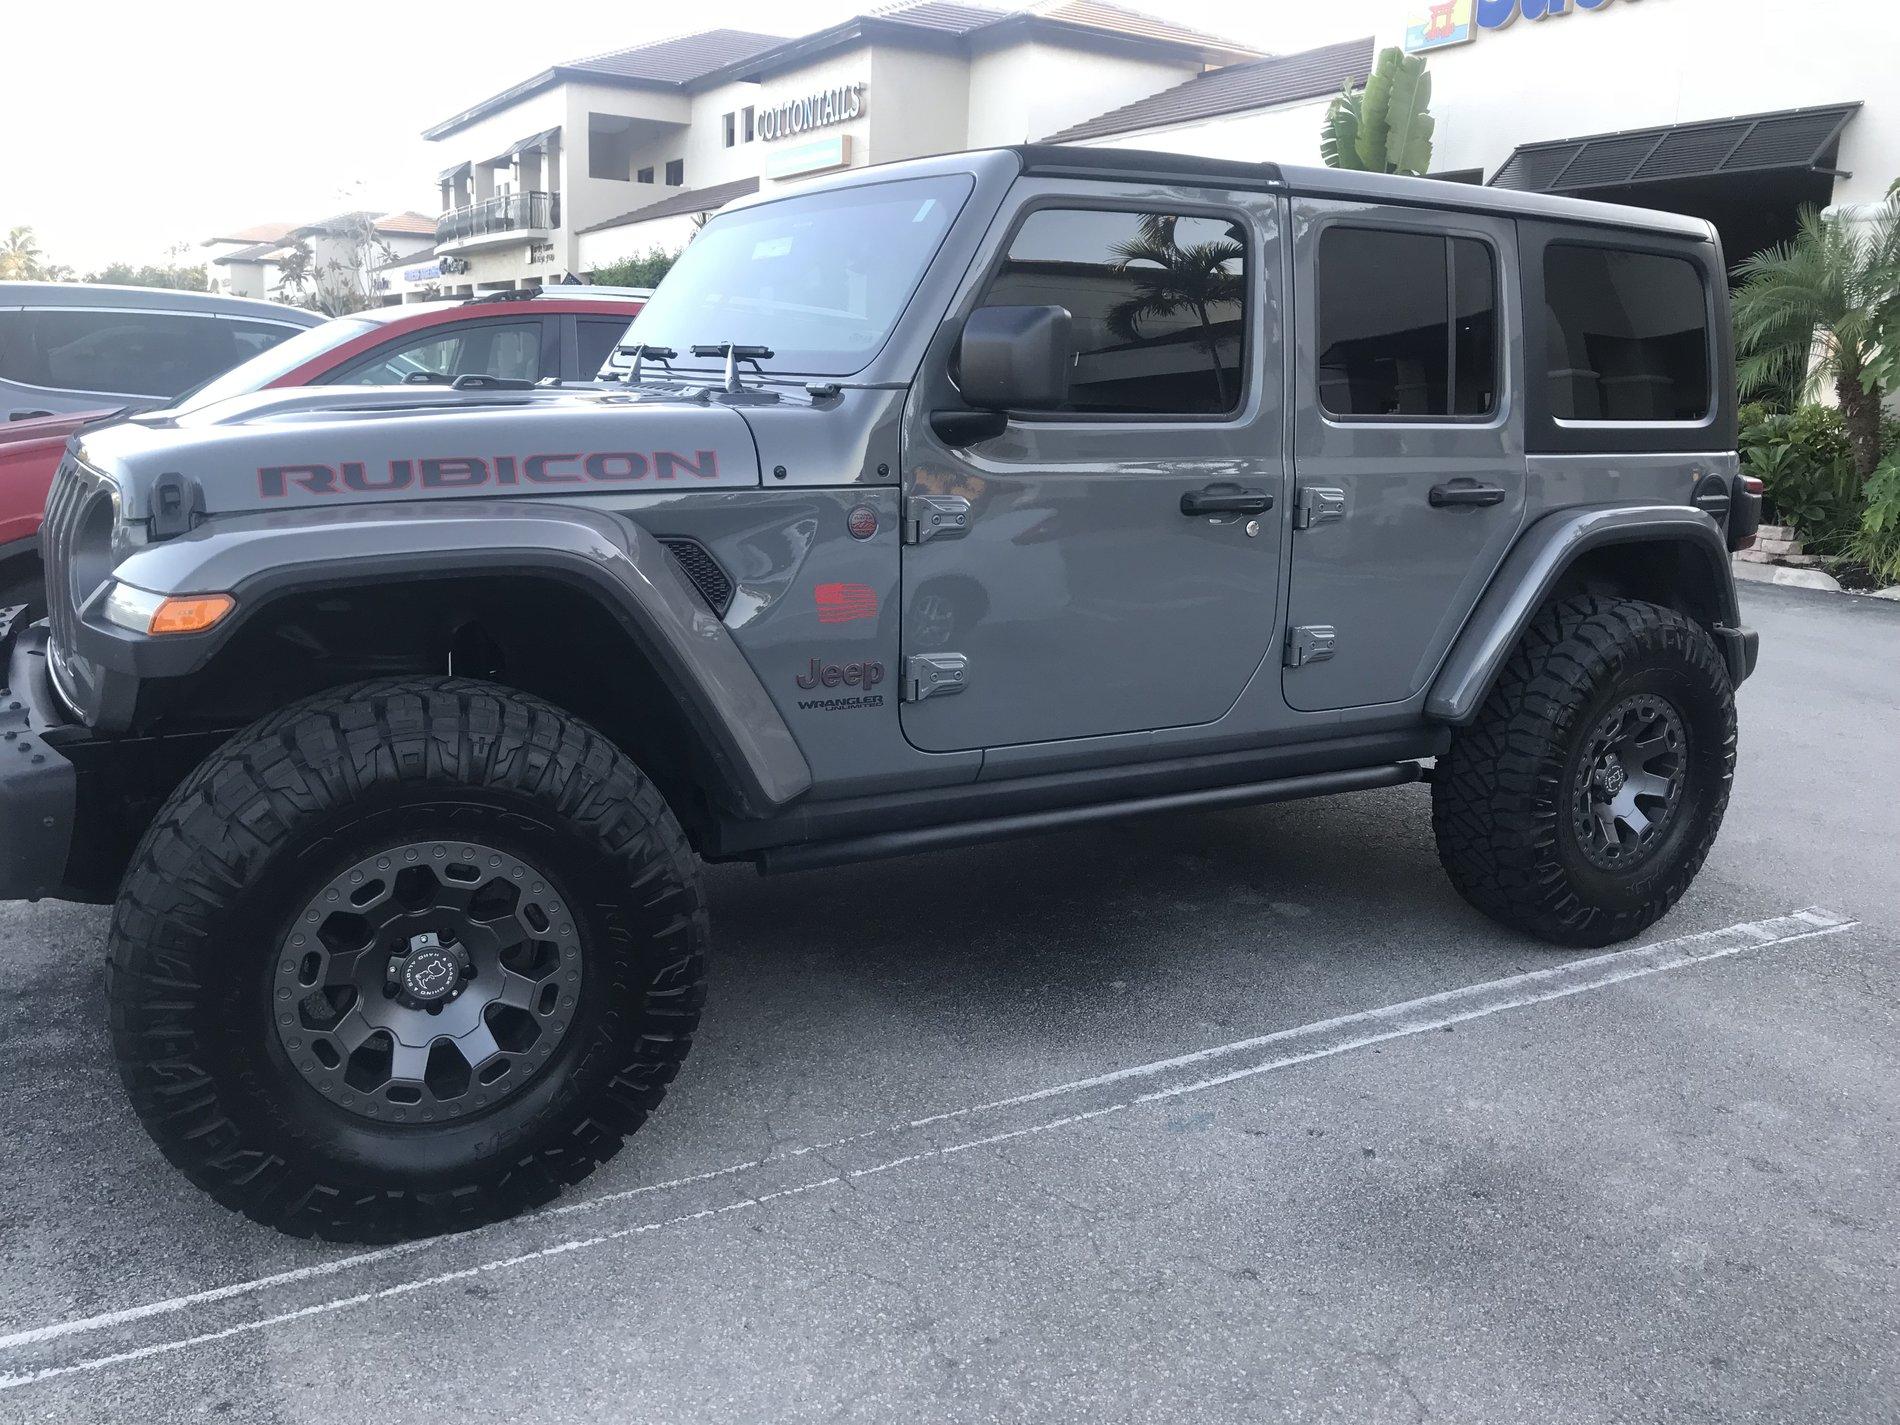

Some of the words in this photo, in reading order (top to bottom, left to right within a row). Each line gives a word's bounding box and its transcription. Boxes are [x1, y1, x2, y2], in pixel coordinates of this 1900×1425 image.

[757, 83, 865, 140] COTTONTAILS
[256, 449, 720, 498] RUBICON
[796, 658, 885, 690] Jeep
[798, 695, 883, 709] WRANGLER
[825, 702, 884, 711] UNLIMITED
[445, 963, 454, 985] BLACK
